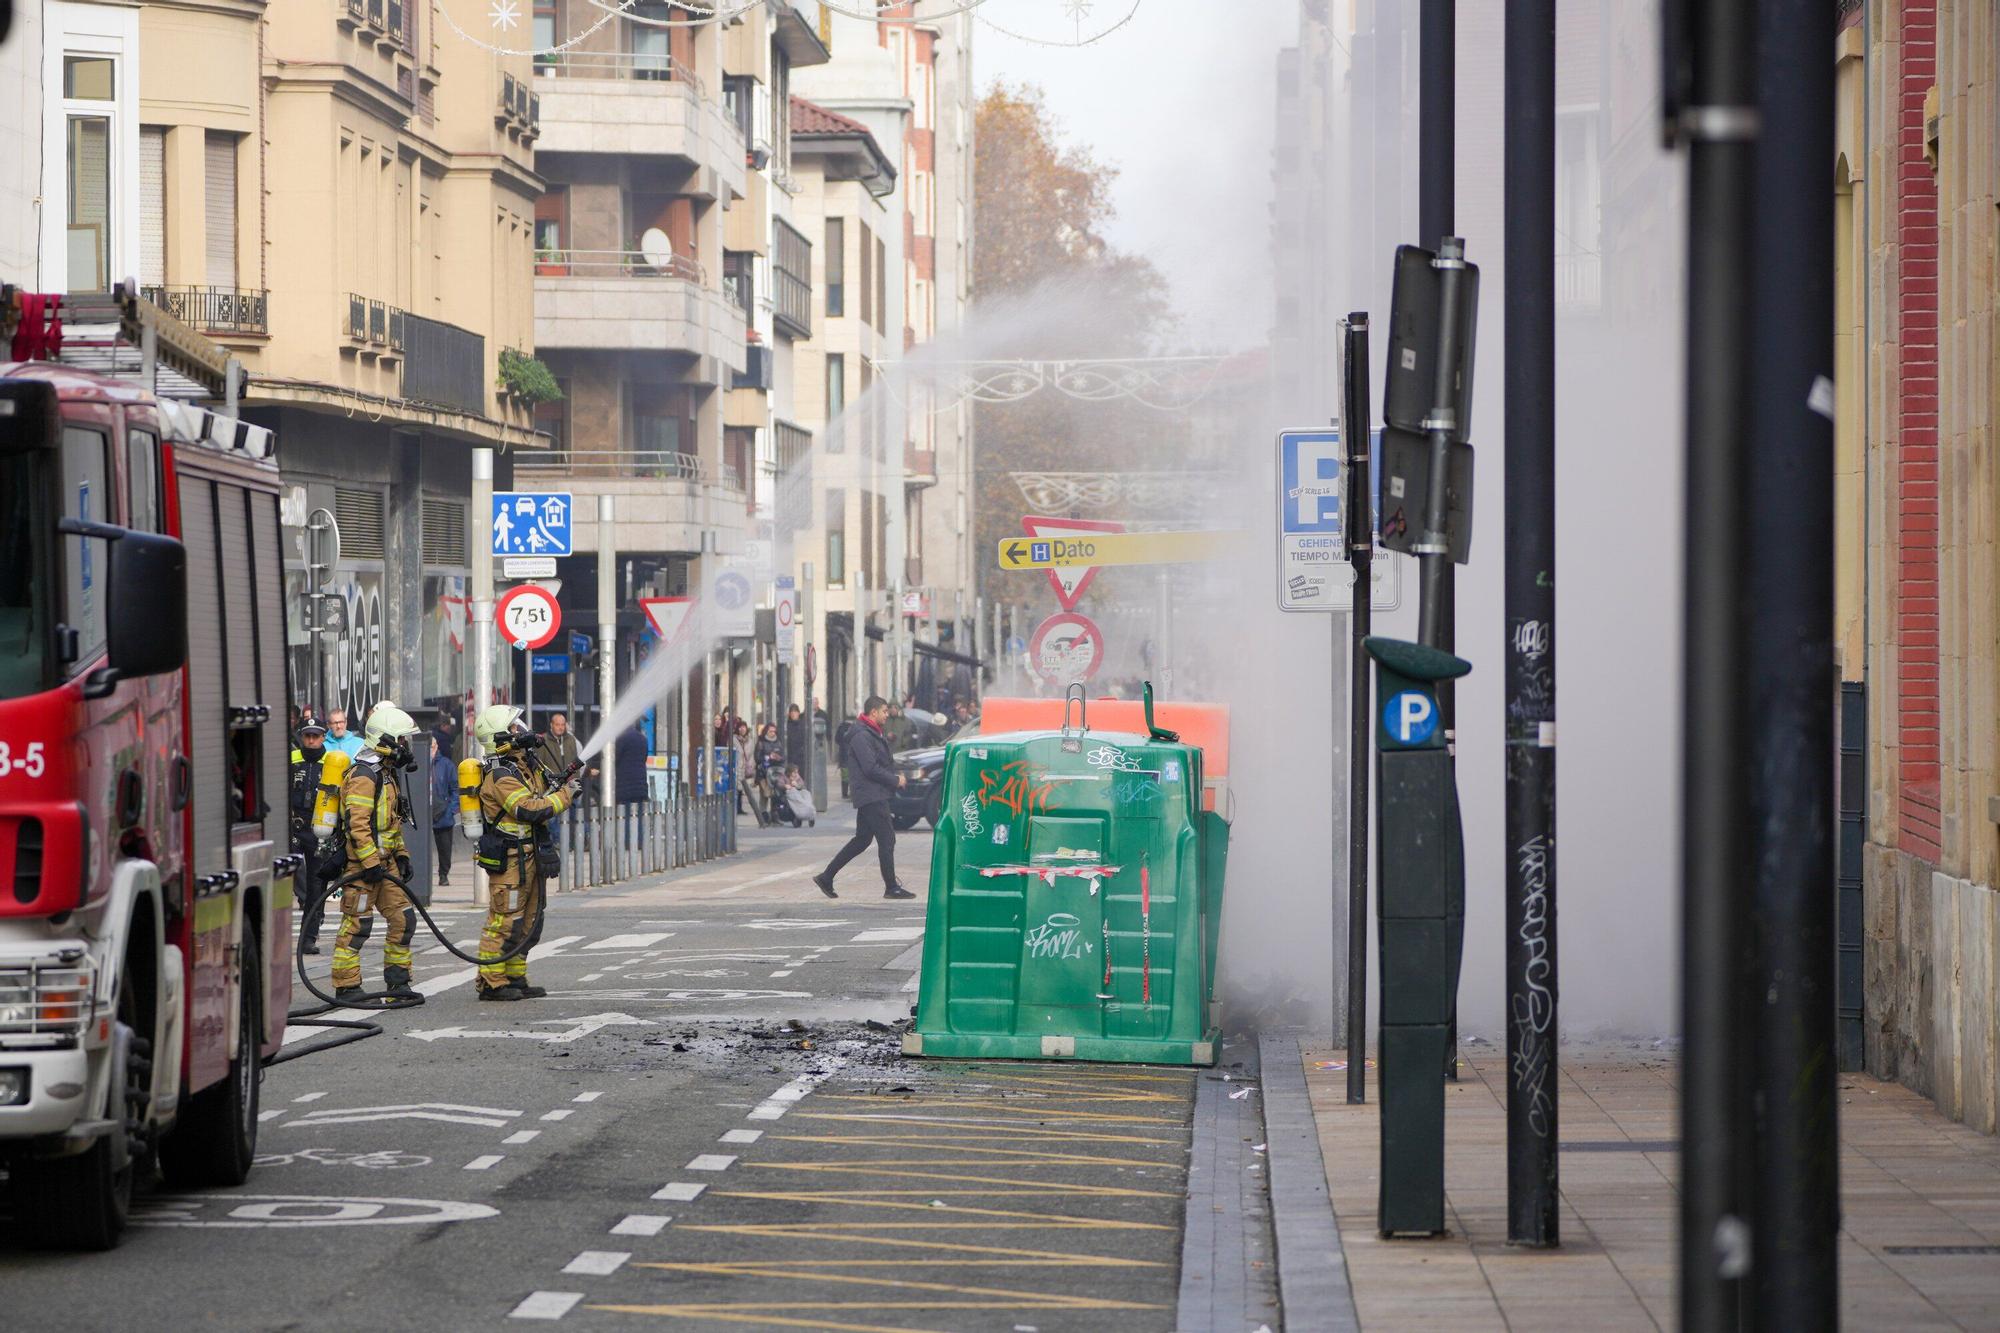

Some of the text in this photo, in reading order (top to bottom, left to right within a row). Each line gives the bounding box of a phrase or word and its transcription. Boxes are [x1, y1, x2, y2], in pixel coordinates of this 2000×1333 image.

[1053, 540, 1096, 558] Dato
[1290, 551, 1331, 561] TIEMPO
[510, 606, 547, 629] 7,5t
[1399, 693, 1432, 741] P
